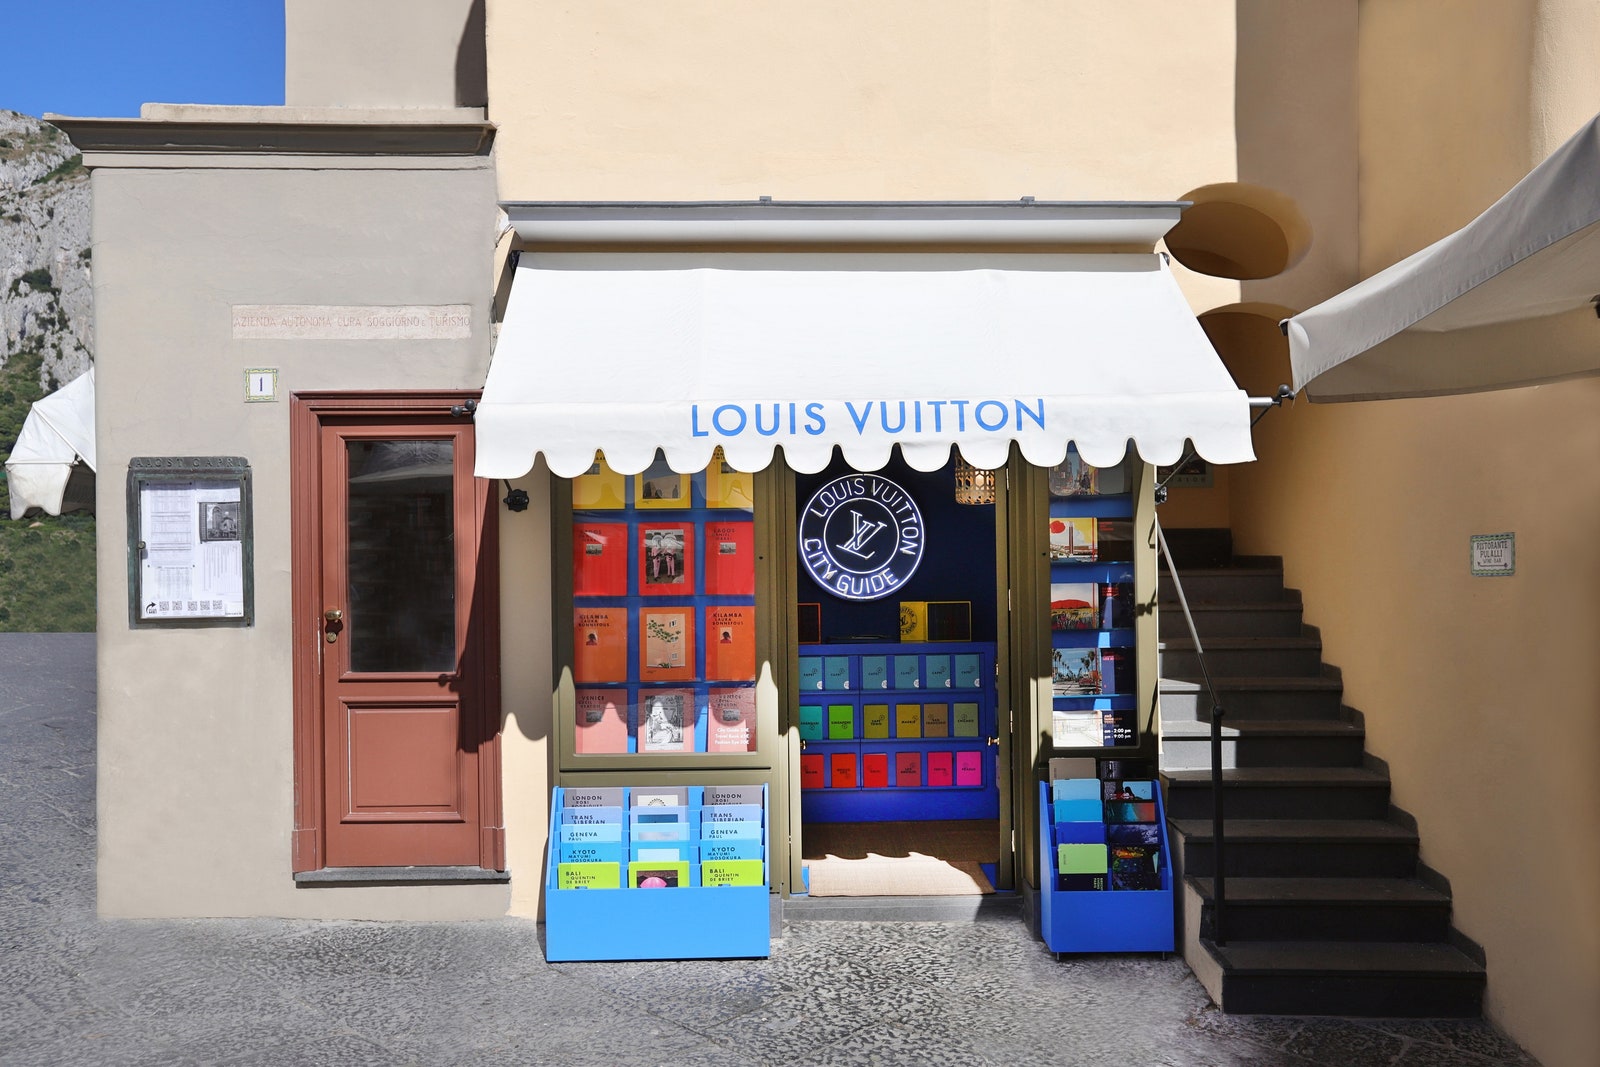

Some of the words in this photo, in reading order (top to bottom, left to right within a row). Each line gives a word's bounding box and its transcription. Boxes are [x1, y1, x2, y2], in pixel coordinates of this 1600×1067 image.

[233, 316, 276, 327] AZIENDA
[280, 316, 331, 327] AUTONOMA
[337, 316, 362, 327] CURA
[366, 315, 419, 327] SOGGIORNO
[429, 314, 471, 327] TURISMO
[692, 402, 826, 437] LOUIS
[845, 399, 1046, 436] VUITTON
[192, 457, 242, 468] CAPRI
[809, 477, 865, 518] LOUIS
[870, 478, 920, 556] VUITTON
[1476, 540, 1508, 550] RISTORANTE
[803, 537, 838, 580] CITY
[836, 566, 899, 596] GUIDE
